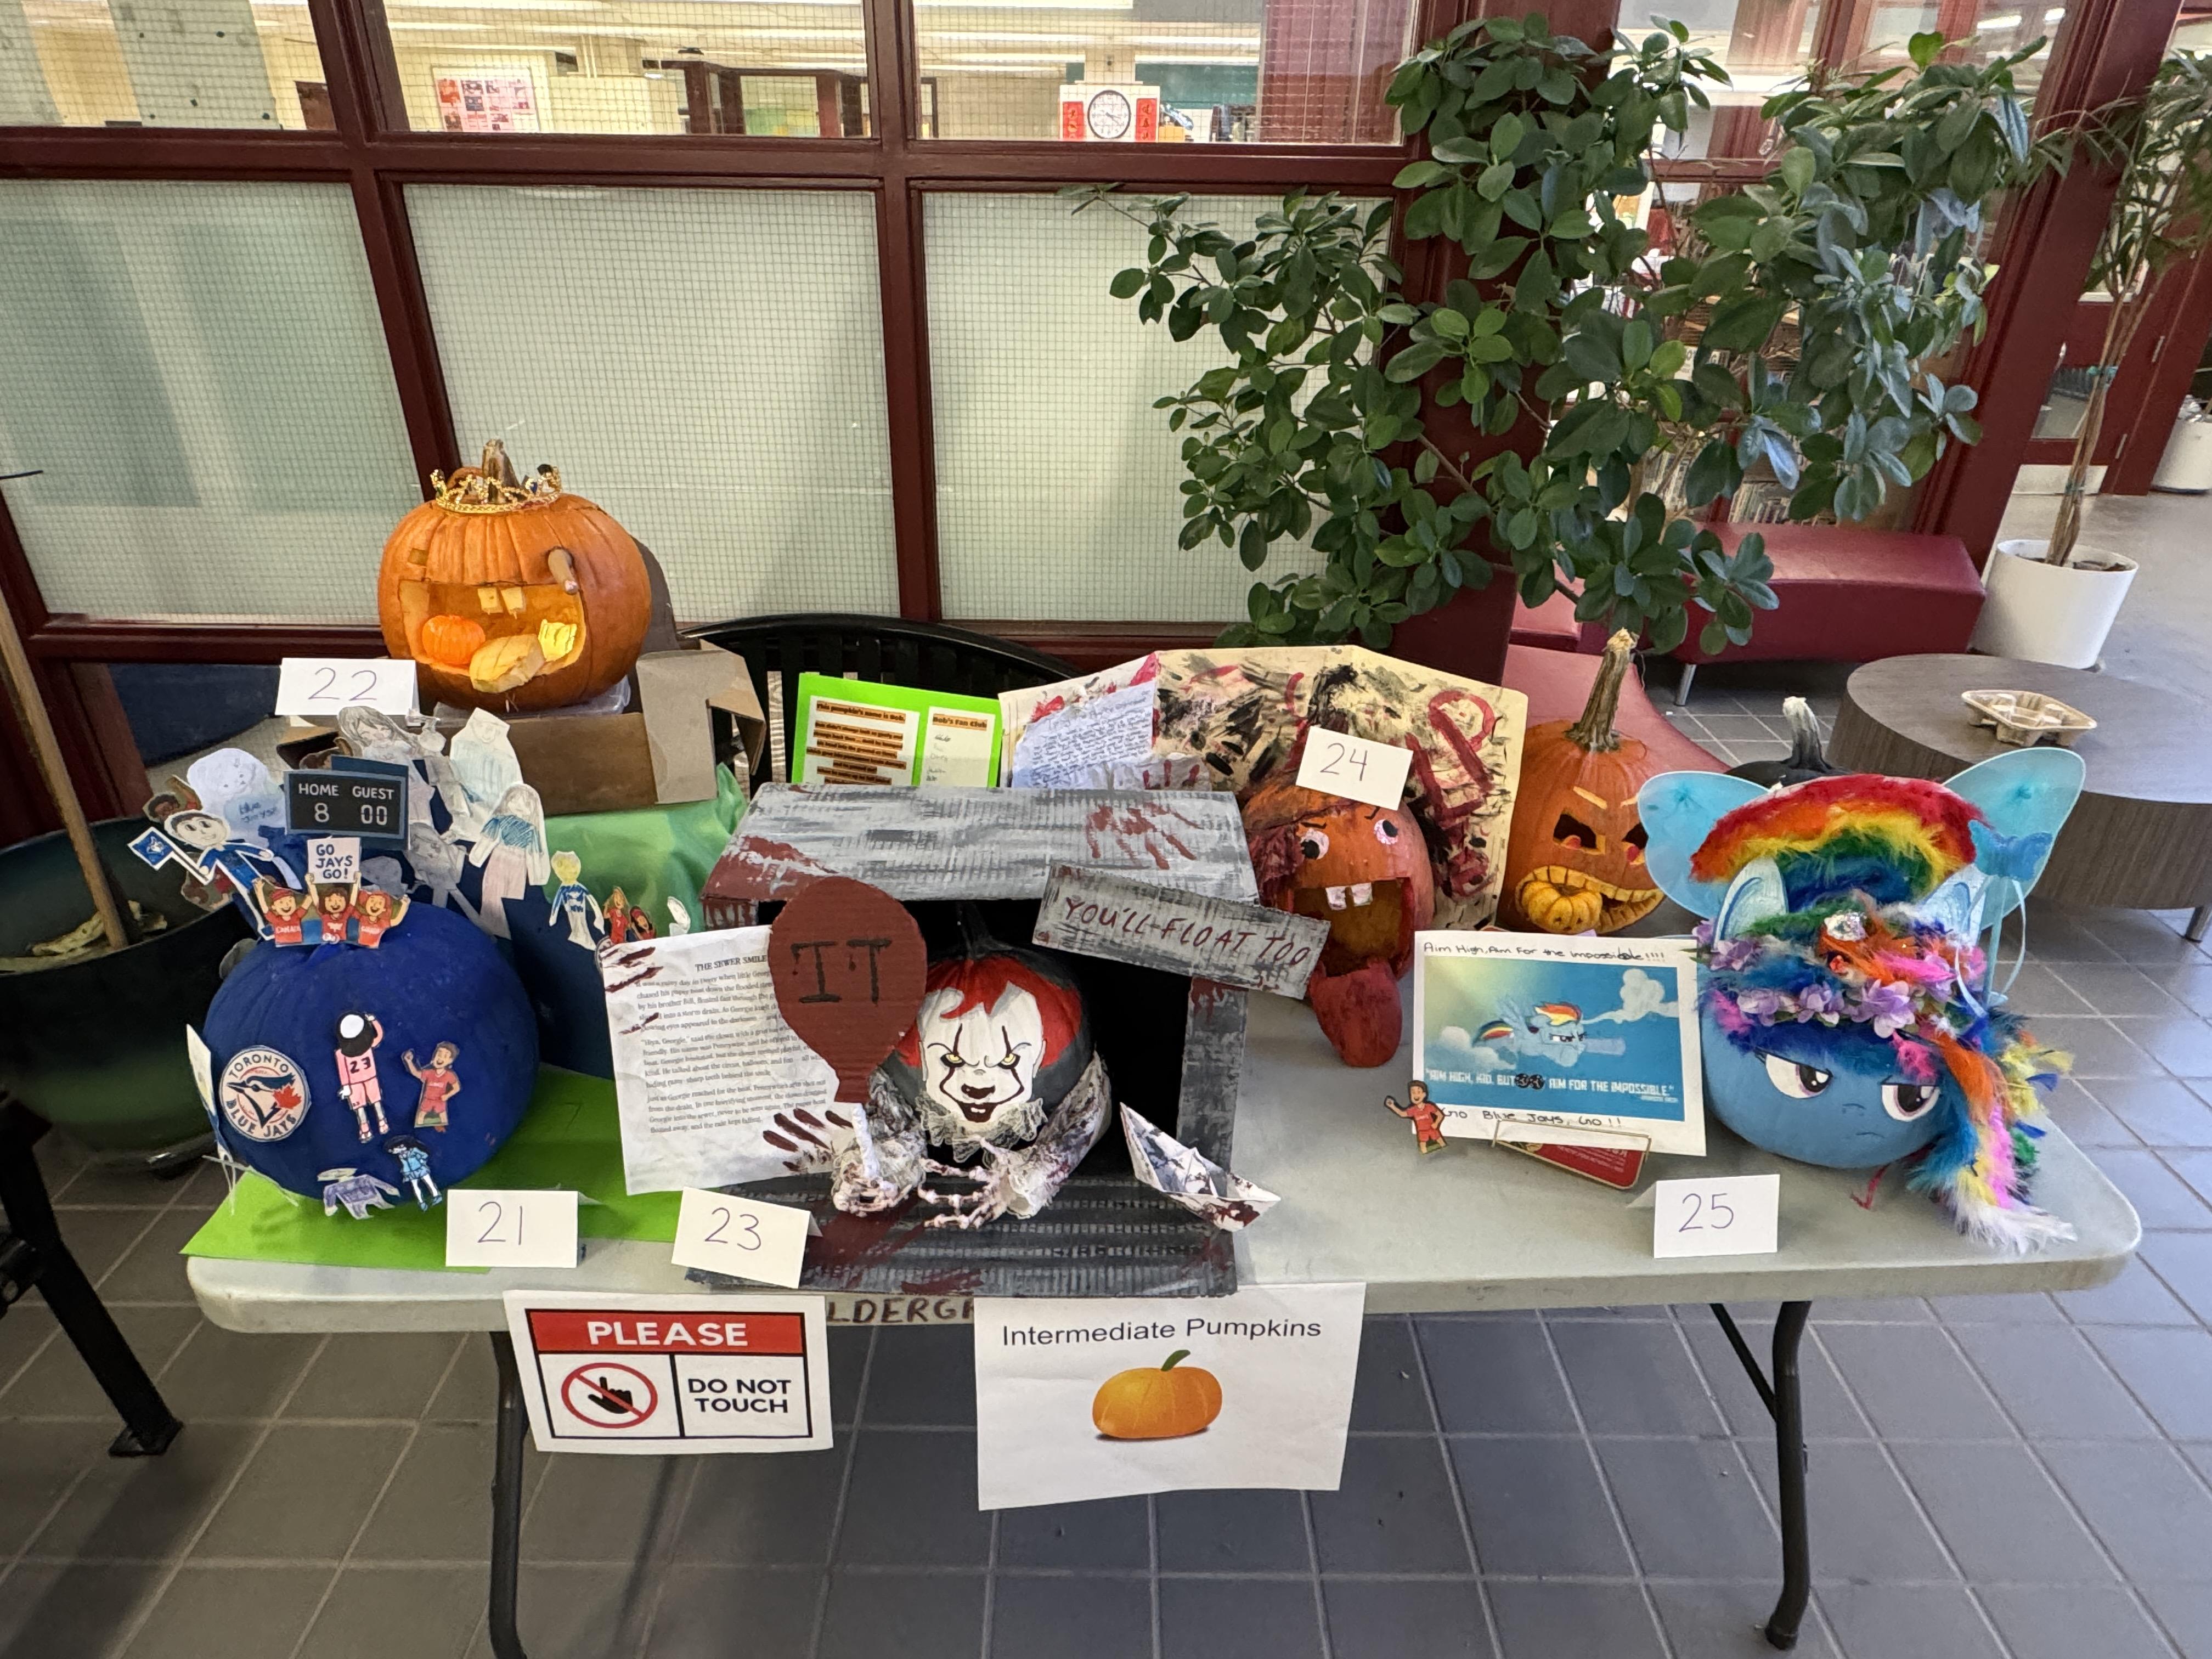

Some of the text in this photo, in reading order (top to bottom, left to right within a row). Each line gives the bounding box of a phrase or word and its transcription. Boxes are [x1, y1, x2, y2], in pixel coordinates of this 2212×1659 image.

[308, 667, 377, 701] 22
[1320, 742, 1368, 781] 24
[298, 783, 394, 799] HOME GUEST
[314, 803, 329, 822] 8
[316, 844, 335, 856] GO
[315, 855, 353, 868] JAYS
[323, 868, 348, 879] GO!
[1065, 897, 1311, 966] YOU'LL FLOAT TOO
[1424, 942, 1451, 952] Aim
[695, 955, 767, 973] THE SEWER SMILE
[791, 939, 892, 1005] IT
[229, 1053, 289, 1079] TORONTO
[349, 1057, 371, 1074] 23
[1549, 1078, 1566, 1089] AIM
[1568, 1079, 1587, 1091] FOR
[1590, 1080, 1609, 1092] THE
[227, 1098, 296, 1138] BLUE JAYS
[477, 1201, 523, 1245] 21
[1678, 1193, 1735, 1233] 25
[704, 1207, 762, 1251] 23
[587, 1321, 748, 1346] PLEASE
[1003, 1318, 1322, 1346] Intermediate Pumpkins
[688, 1378, 791, 1394] DO NOT
[694, 1398, 788, 1413] TOUCH
